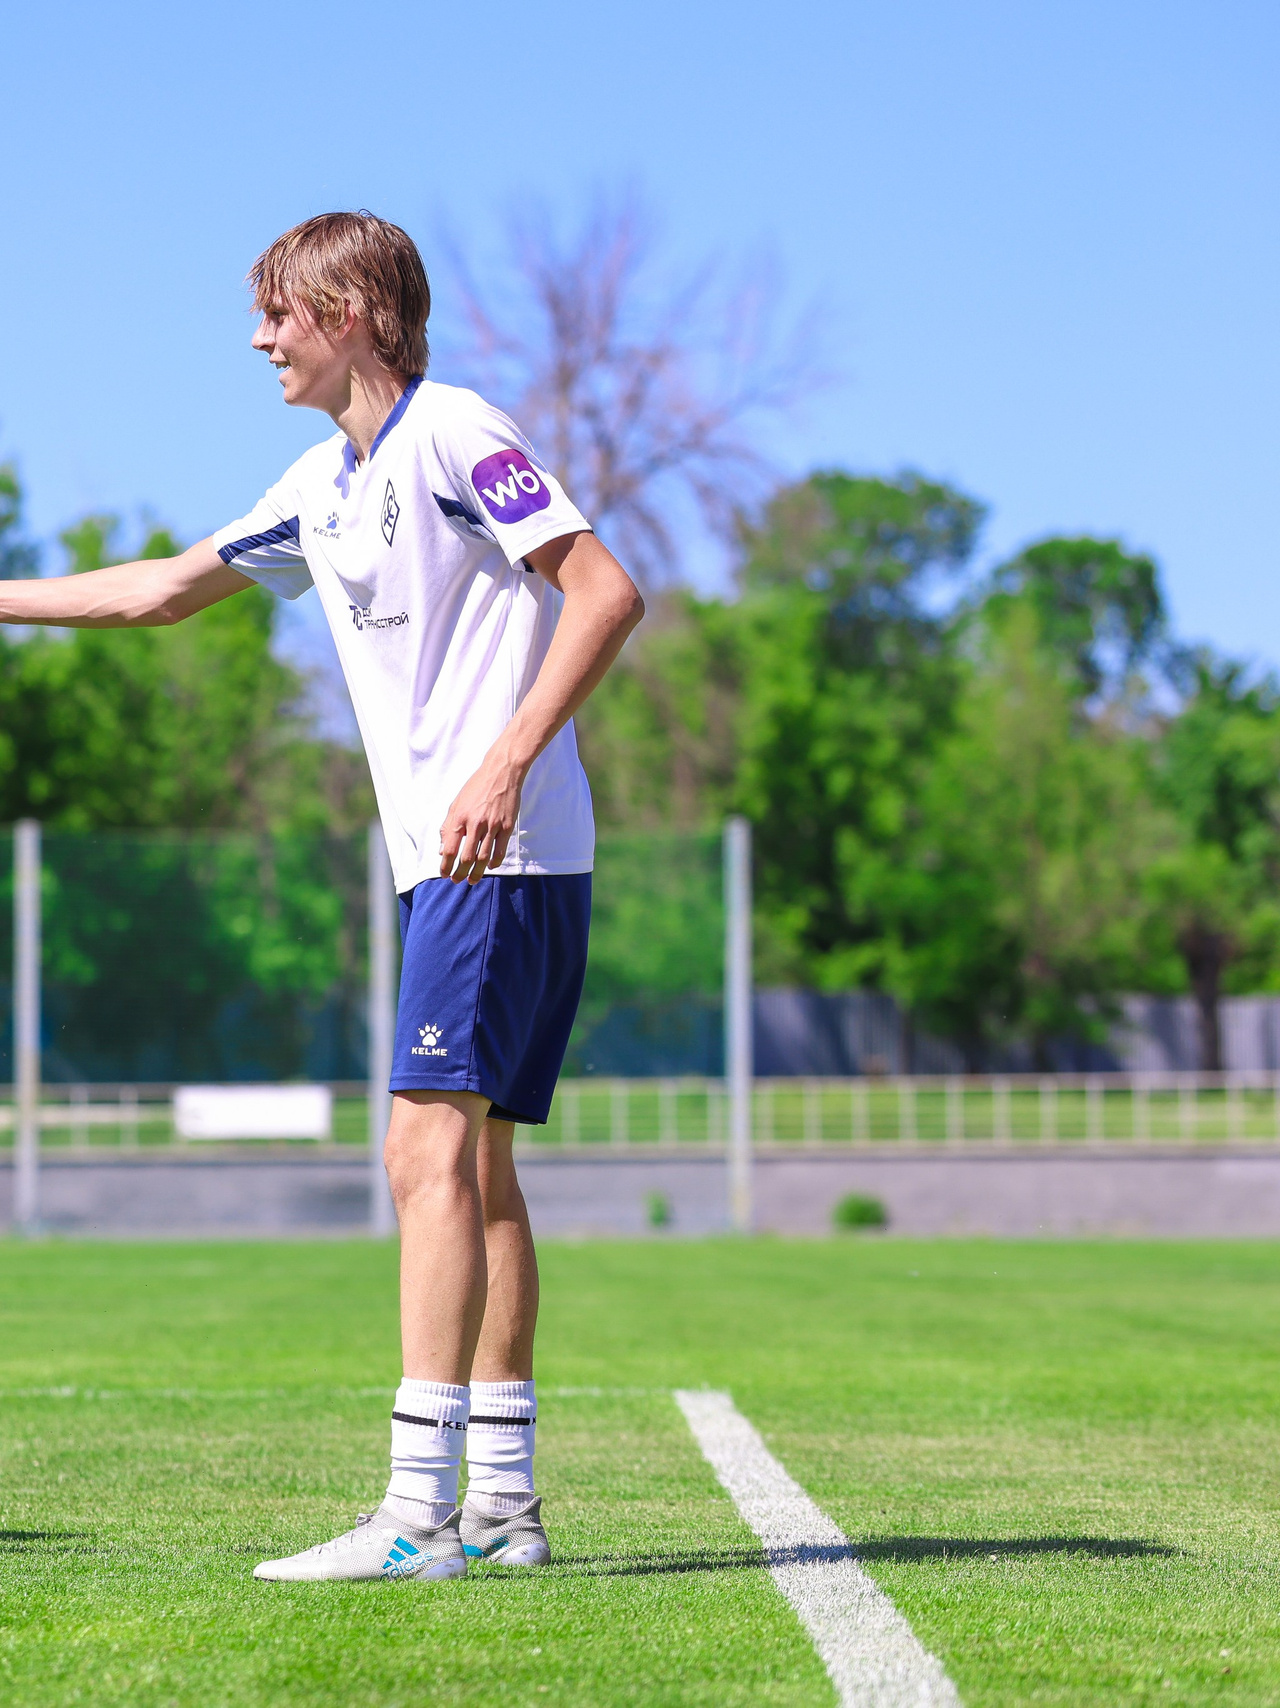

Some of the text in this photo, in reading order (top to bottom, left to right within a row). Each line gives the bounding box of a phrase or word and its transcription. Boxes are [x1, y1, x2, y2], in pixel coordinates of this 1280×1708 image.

[481, 463, 540, 508] wb
[313, 526, 342, 540] KELME
[411, 1046, 448, 1057] KELME
[442, 1419, 468, 1431] KEL
